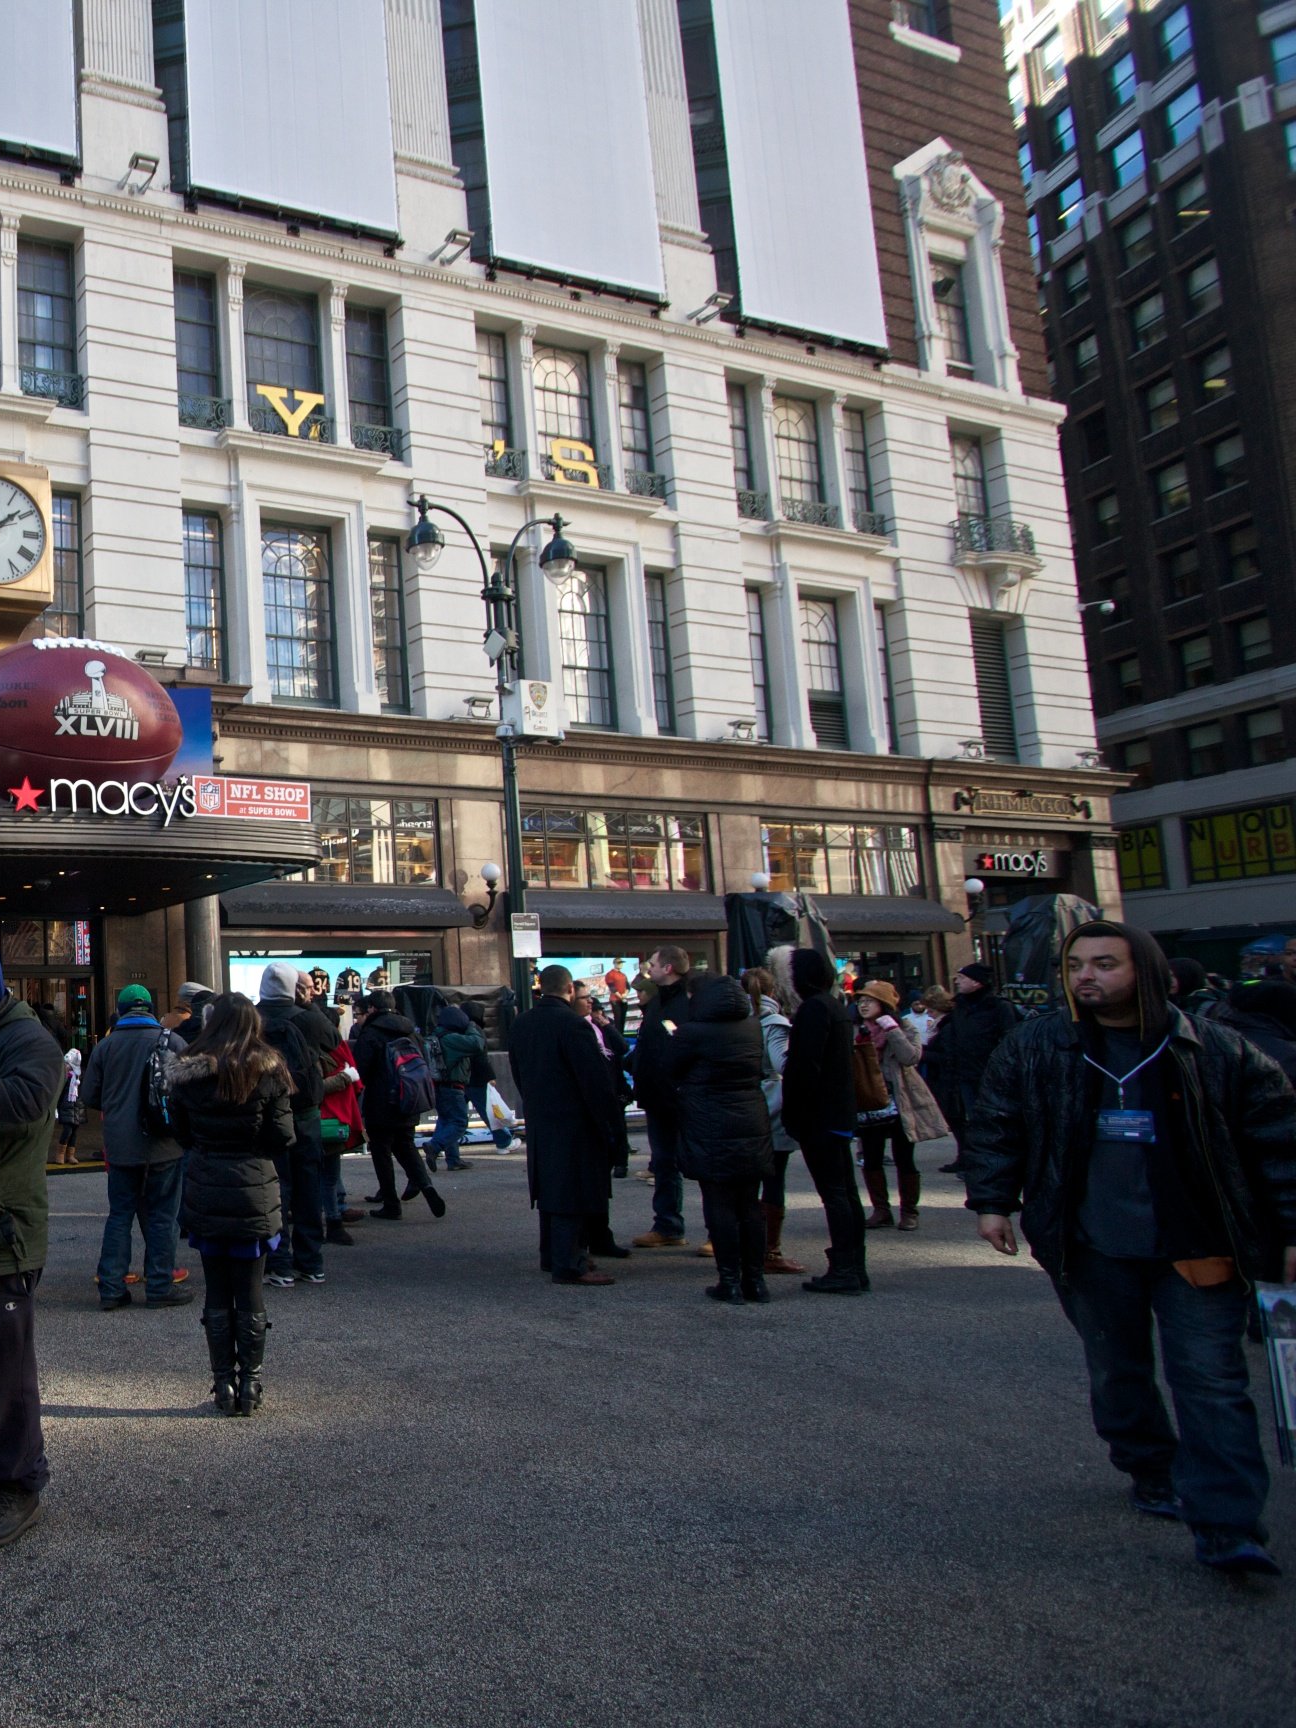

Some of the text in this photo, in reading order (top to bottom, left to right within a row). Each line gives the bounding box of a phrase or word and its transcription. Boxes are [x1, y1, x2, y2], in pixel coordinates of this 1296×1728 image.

[74, 707, 124, 717] SUPER BOWL
[54, 715, 140, 741] XLVIII
[230, 784, 305, 802] NFL SHOP
[248, 807, 274, 816] SUPER
[275, 808, 297, 817] BOWL
[347, 975, 361, 992] 19
